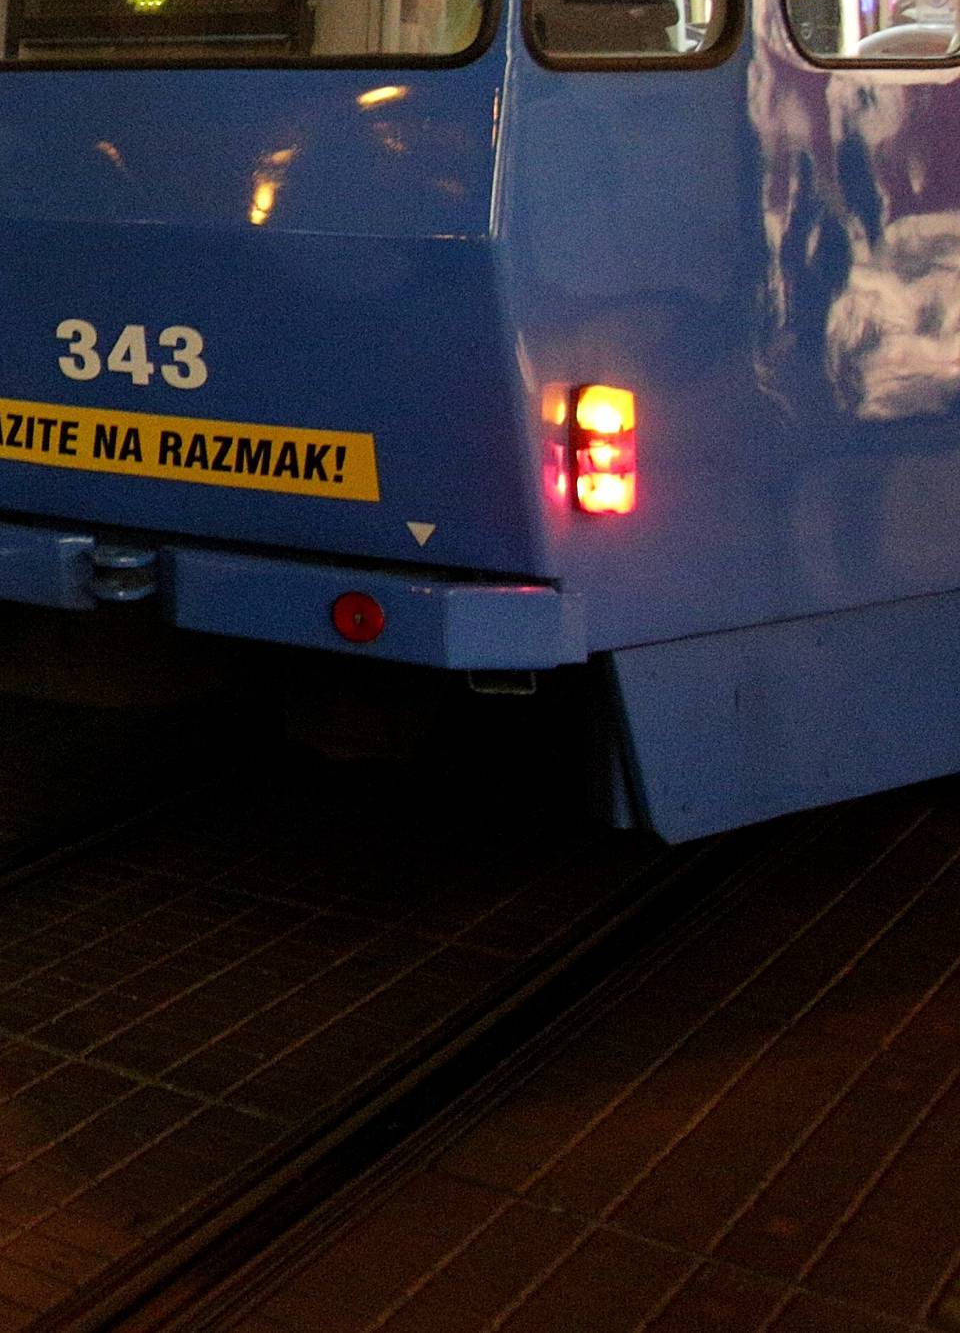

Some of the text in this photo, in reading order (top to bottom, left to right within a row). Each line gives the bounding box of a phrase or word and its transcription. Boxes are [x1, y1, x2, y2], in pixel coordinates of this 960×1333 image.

[56, 318, 208, 389] 343
[92, 423, 144, 464] NA
[158, 430, 347, 484] RAZMAK!
